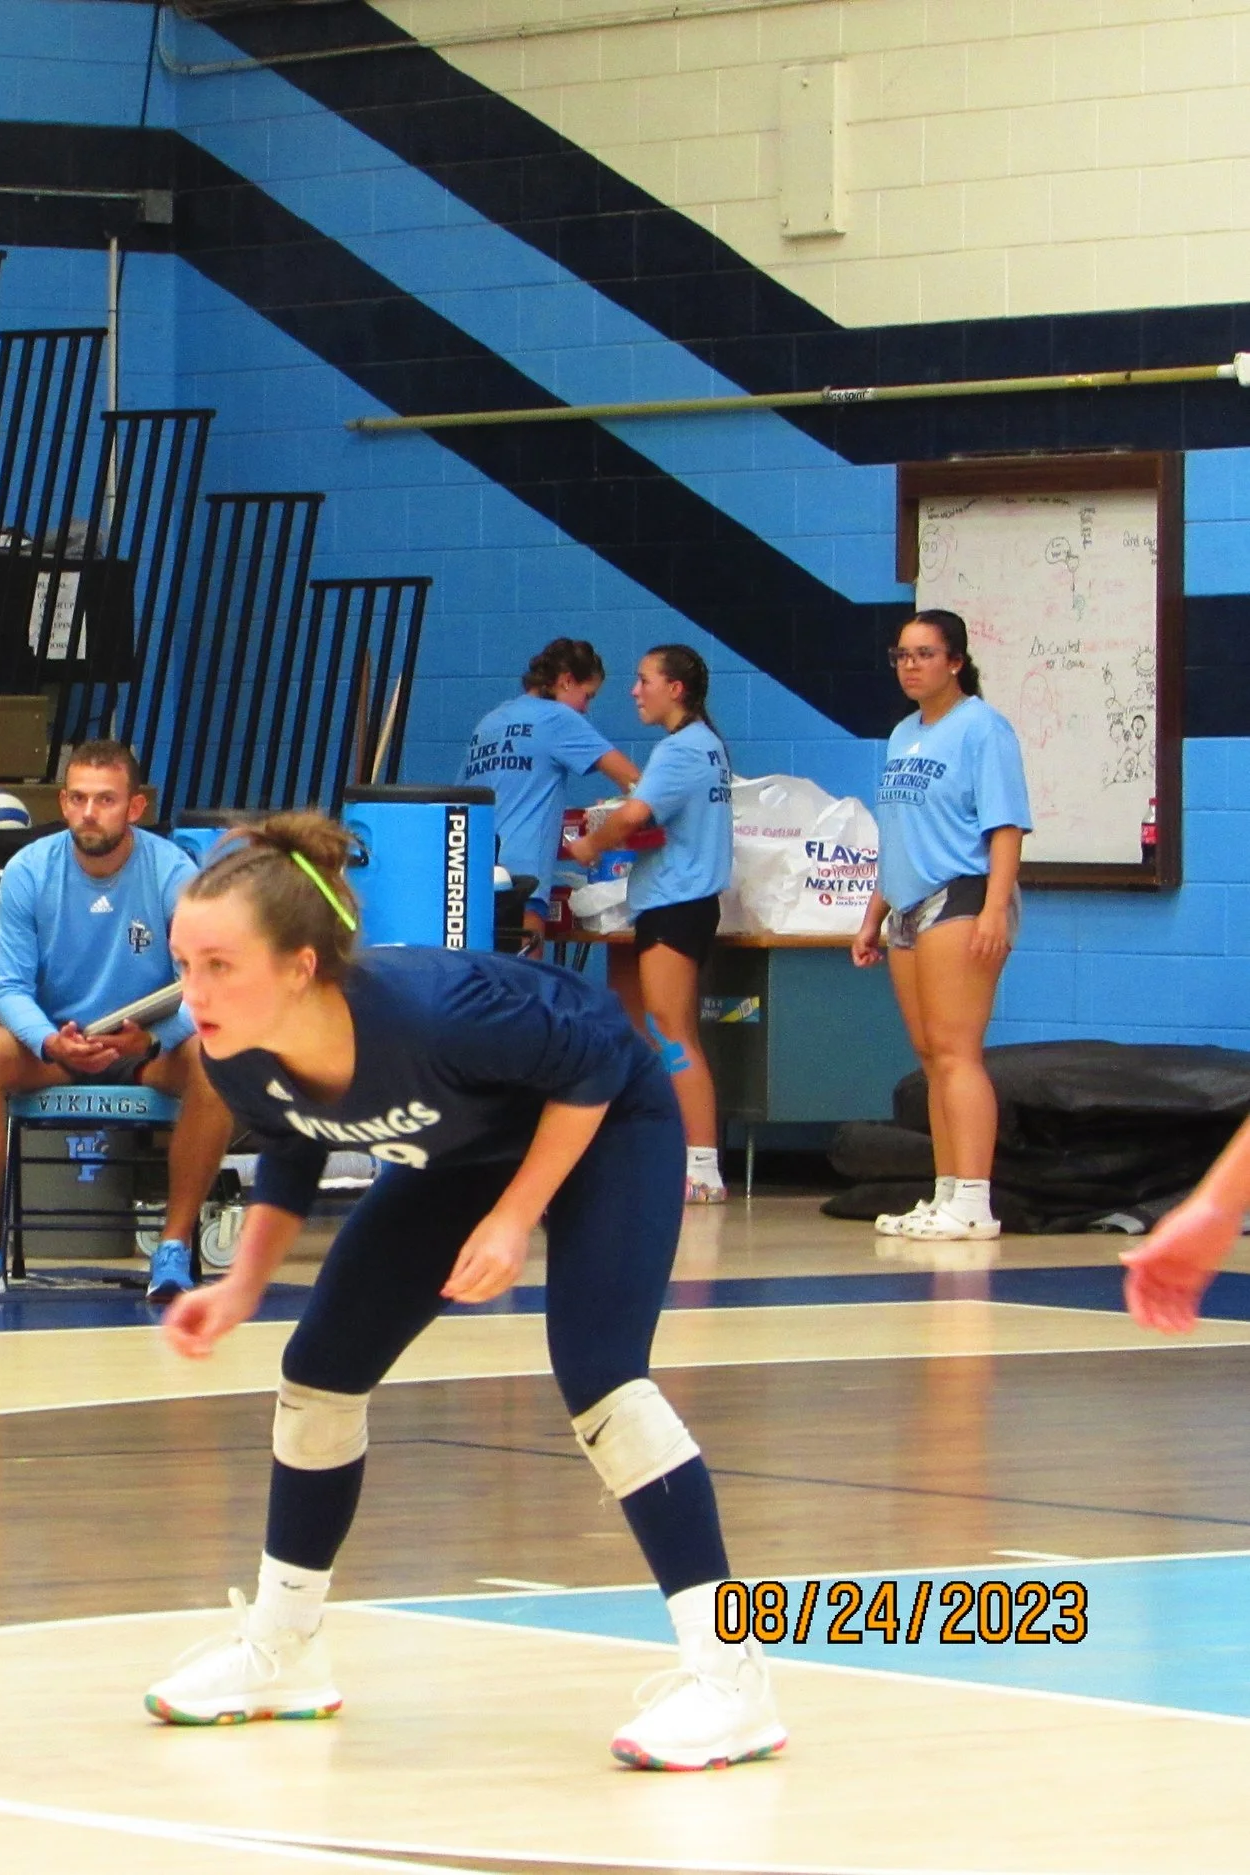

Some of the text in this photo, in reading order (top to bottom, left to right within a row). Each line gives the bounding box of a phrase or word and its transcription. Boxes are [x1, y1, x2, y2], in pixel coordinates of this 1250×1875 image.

[470, 739, 514, 762] LIKE A
[465, 755, 533, 780] HAMPION
[446, 814, 467, 950] POWERADE
[805, 877, 876, 892] NEXT EVE
[38, 1095, 149, 1114] VIKINGS
[284, 1100, 442, 1142] VIKINGS
